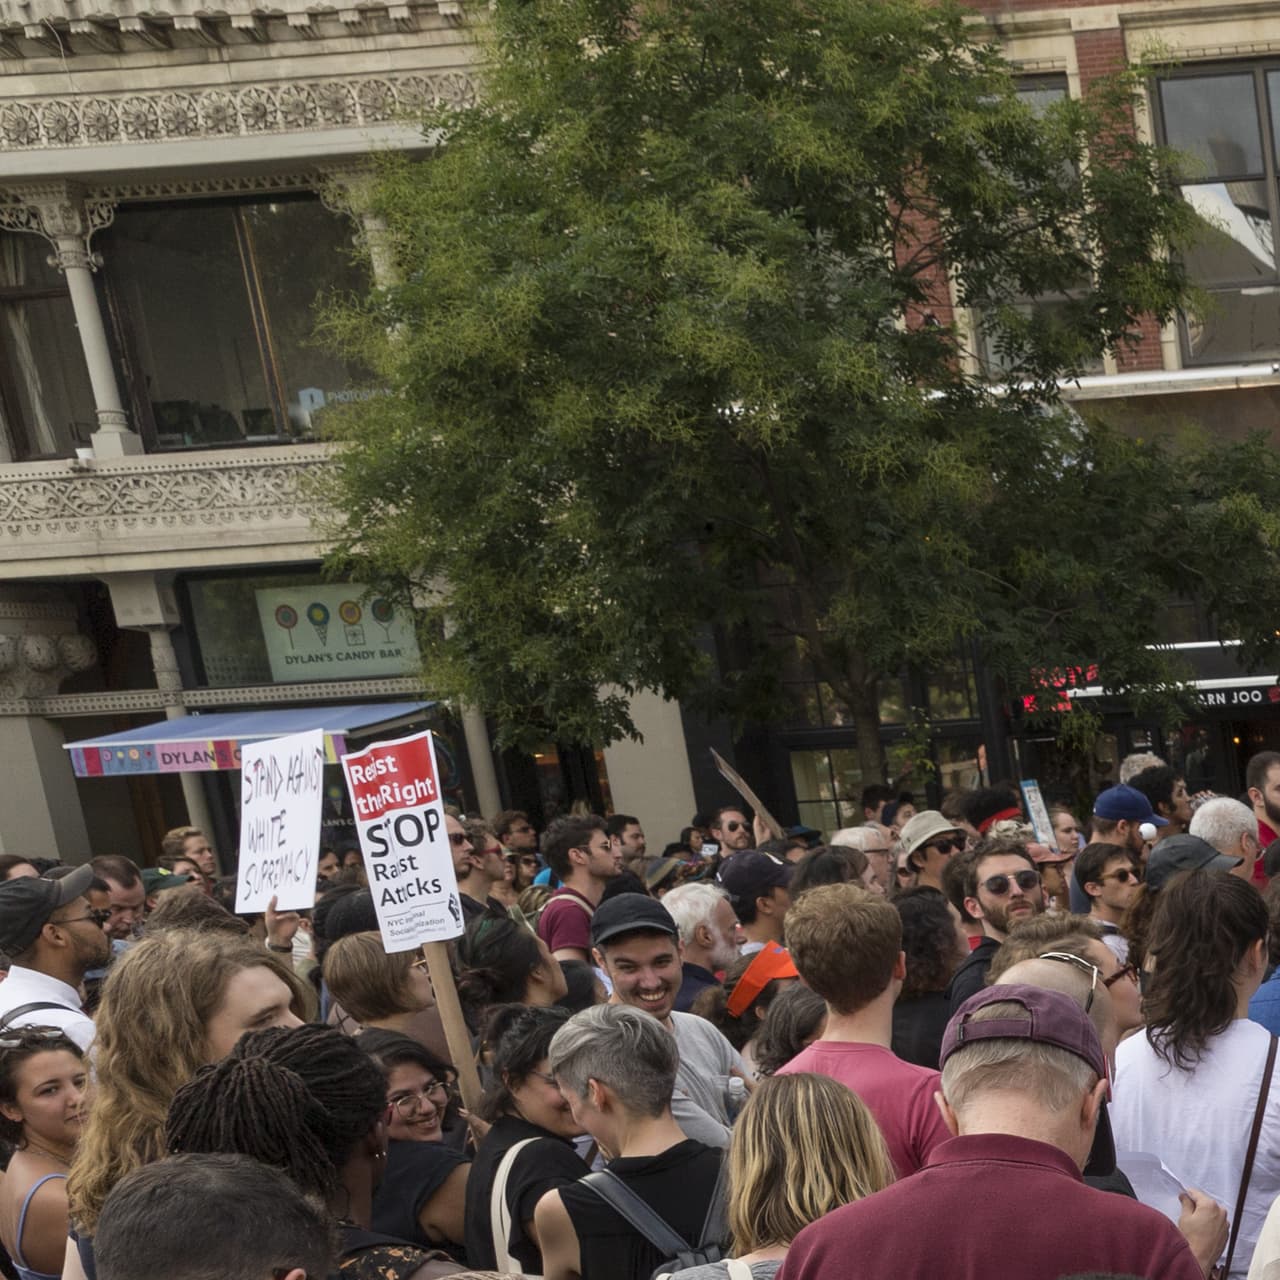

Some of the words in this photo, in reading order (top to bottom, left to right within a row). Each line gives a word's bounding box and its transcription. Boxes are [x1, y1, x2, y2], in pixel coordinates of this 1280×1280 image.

[285, 652, 333, 665] DYLAN'S
[336, 649, 376, 661] CANDY
[380, 648, 402, 658] BAR
[1231, 690, 1262, 704] JOO
[161, 750, 228, 765] DYLAN'S
[244, 754, 283, 804] STAND
[380, 777, 434, 805] Right
[247, 809, 286, 854] WHITE
[244, 847, 312, 901] SUPREMACY
[373, 854, 419, 882] Rast
[381, 877, 442, 907] Attcks
